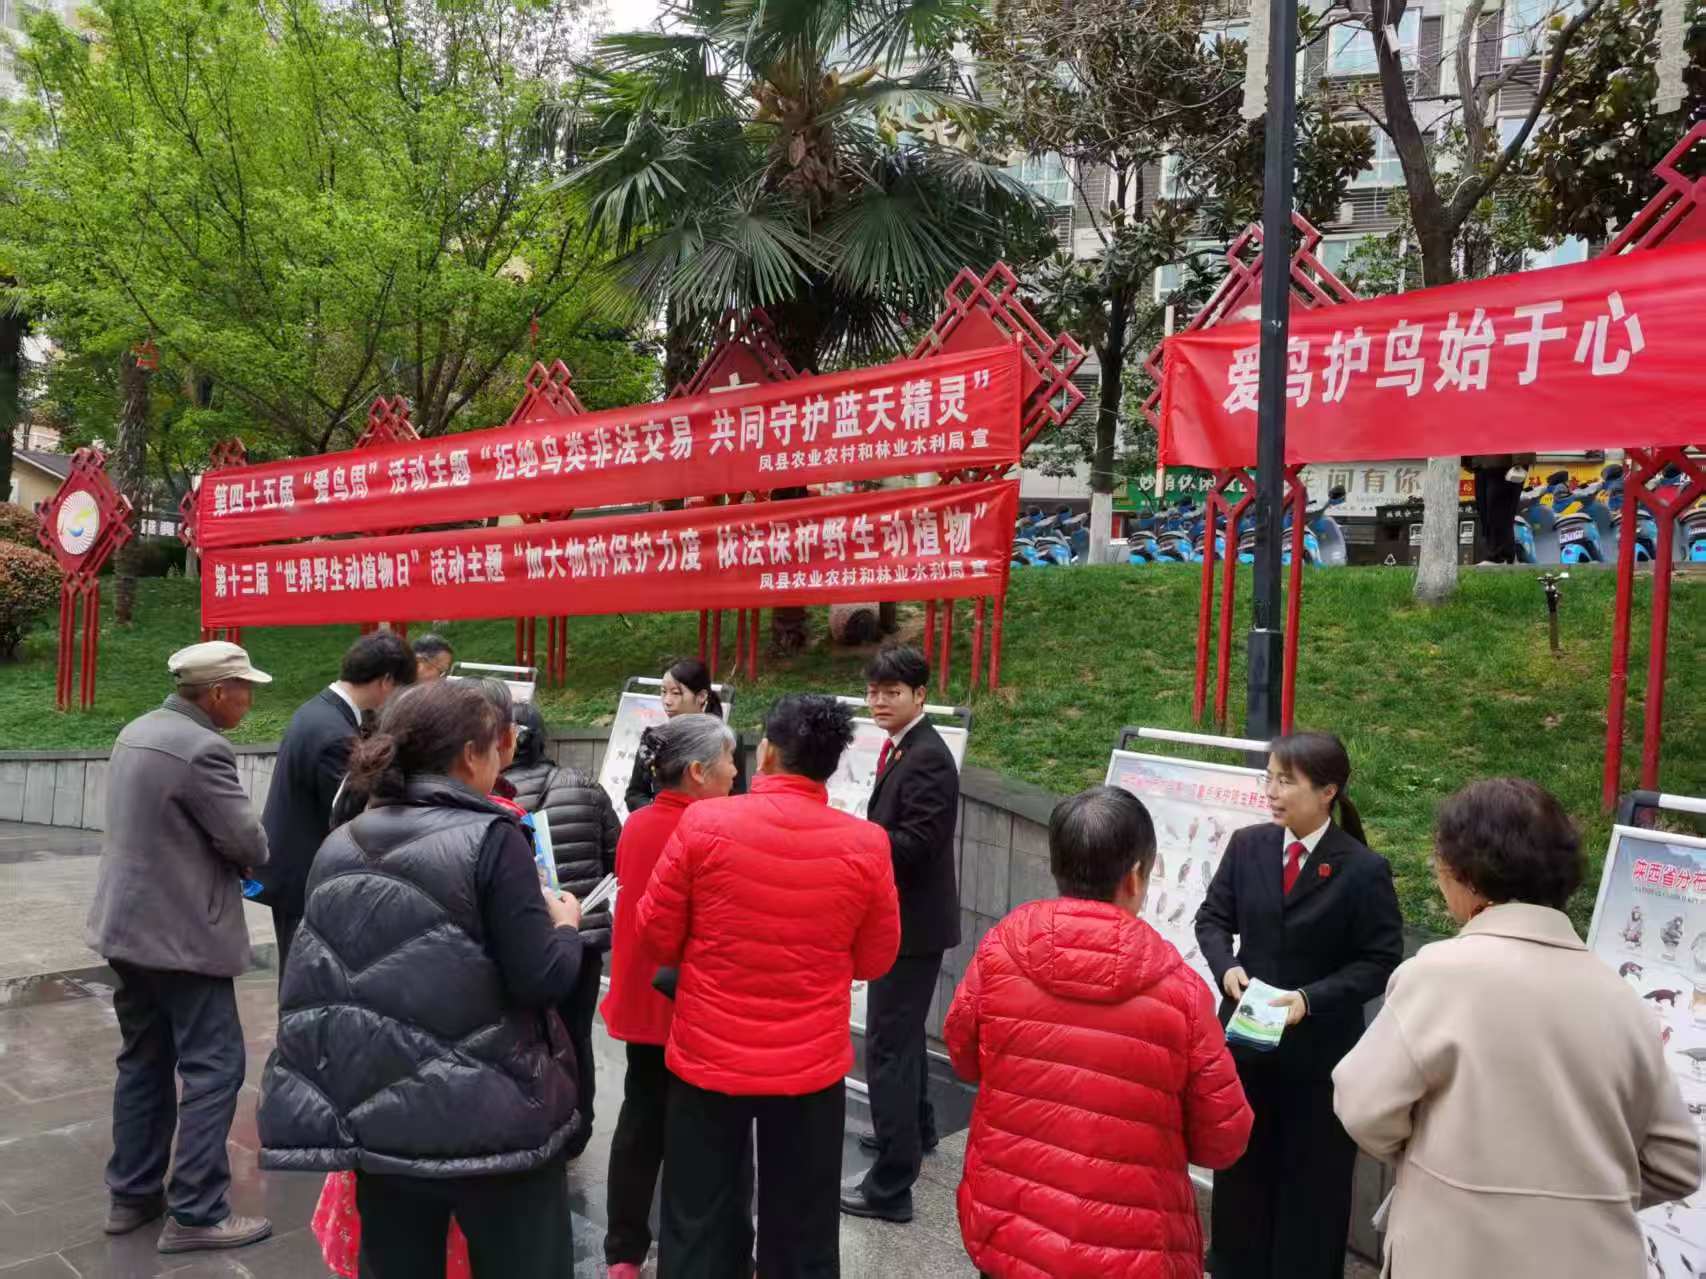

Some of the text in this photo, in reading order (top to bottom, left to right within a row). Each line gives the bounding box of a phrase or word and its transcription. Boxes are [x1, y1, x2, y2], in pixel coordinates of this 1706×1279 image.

[1221, 290, 1645, 414] 爱鸟护鸟始于心
[758, 428, 990, 473] 凤县农业农村和林业水利局 宣
[759, 559, 990, 591] 凤县农业农村和林业水利局 宣
